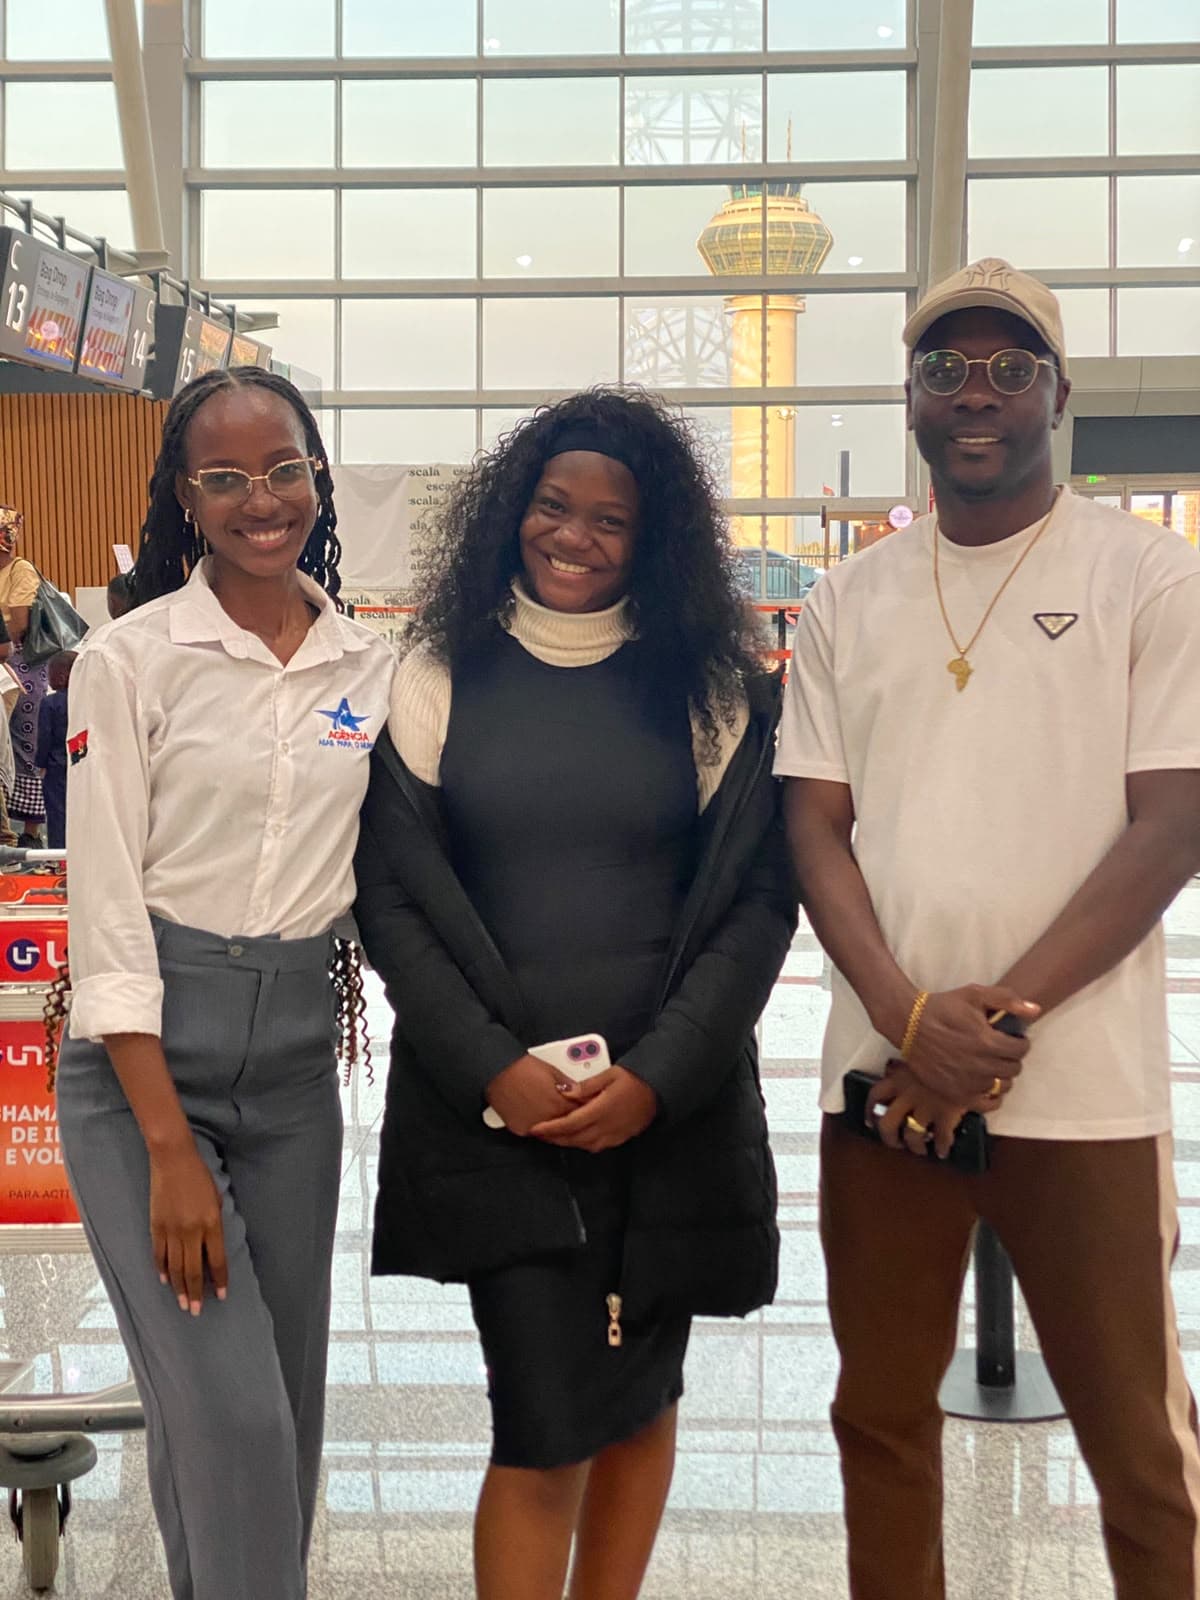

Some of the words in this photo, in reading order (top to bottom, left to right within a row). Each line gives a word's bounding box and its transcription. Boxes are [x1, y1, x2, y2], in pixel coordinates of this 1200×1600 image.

[11, 240, 22, 271] C
[40, 260, 53, 285] Bag
[53, 266, 67, 290] Drop
[6, 281, 28, 333] 13
[131, 328, 147, 368] 14
[180, 347, 195, 384] 15
[408, 466, 440, 477] scala
[408, 495, 440, 505] scala
[342, 595, 371, 605] scala
[11, 1126, 39, 1144] DE
[5, 1148, 17, 1166] E
[22, 1148, 64, 1166] VOL
[9, 1189, 39, 1200] PARA
[42, 1188, 70, 1200] ACTI
